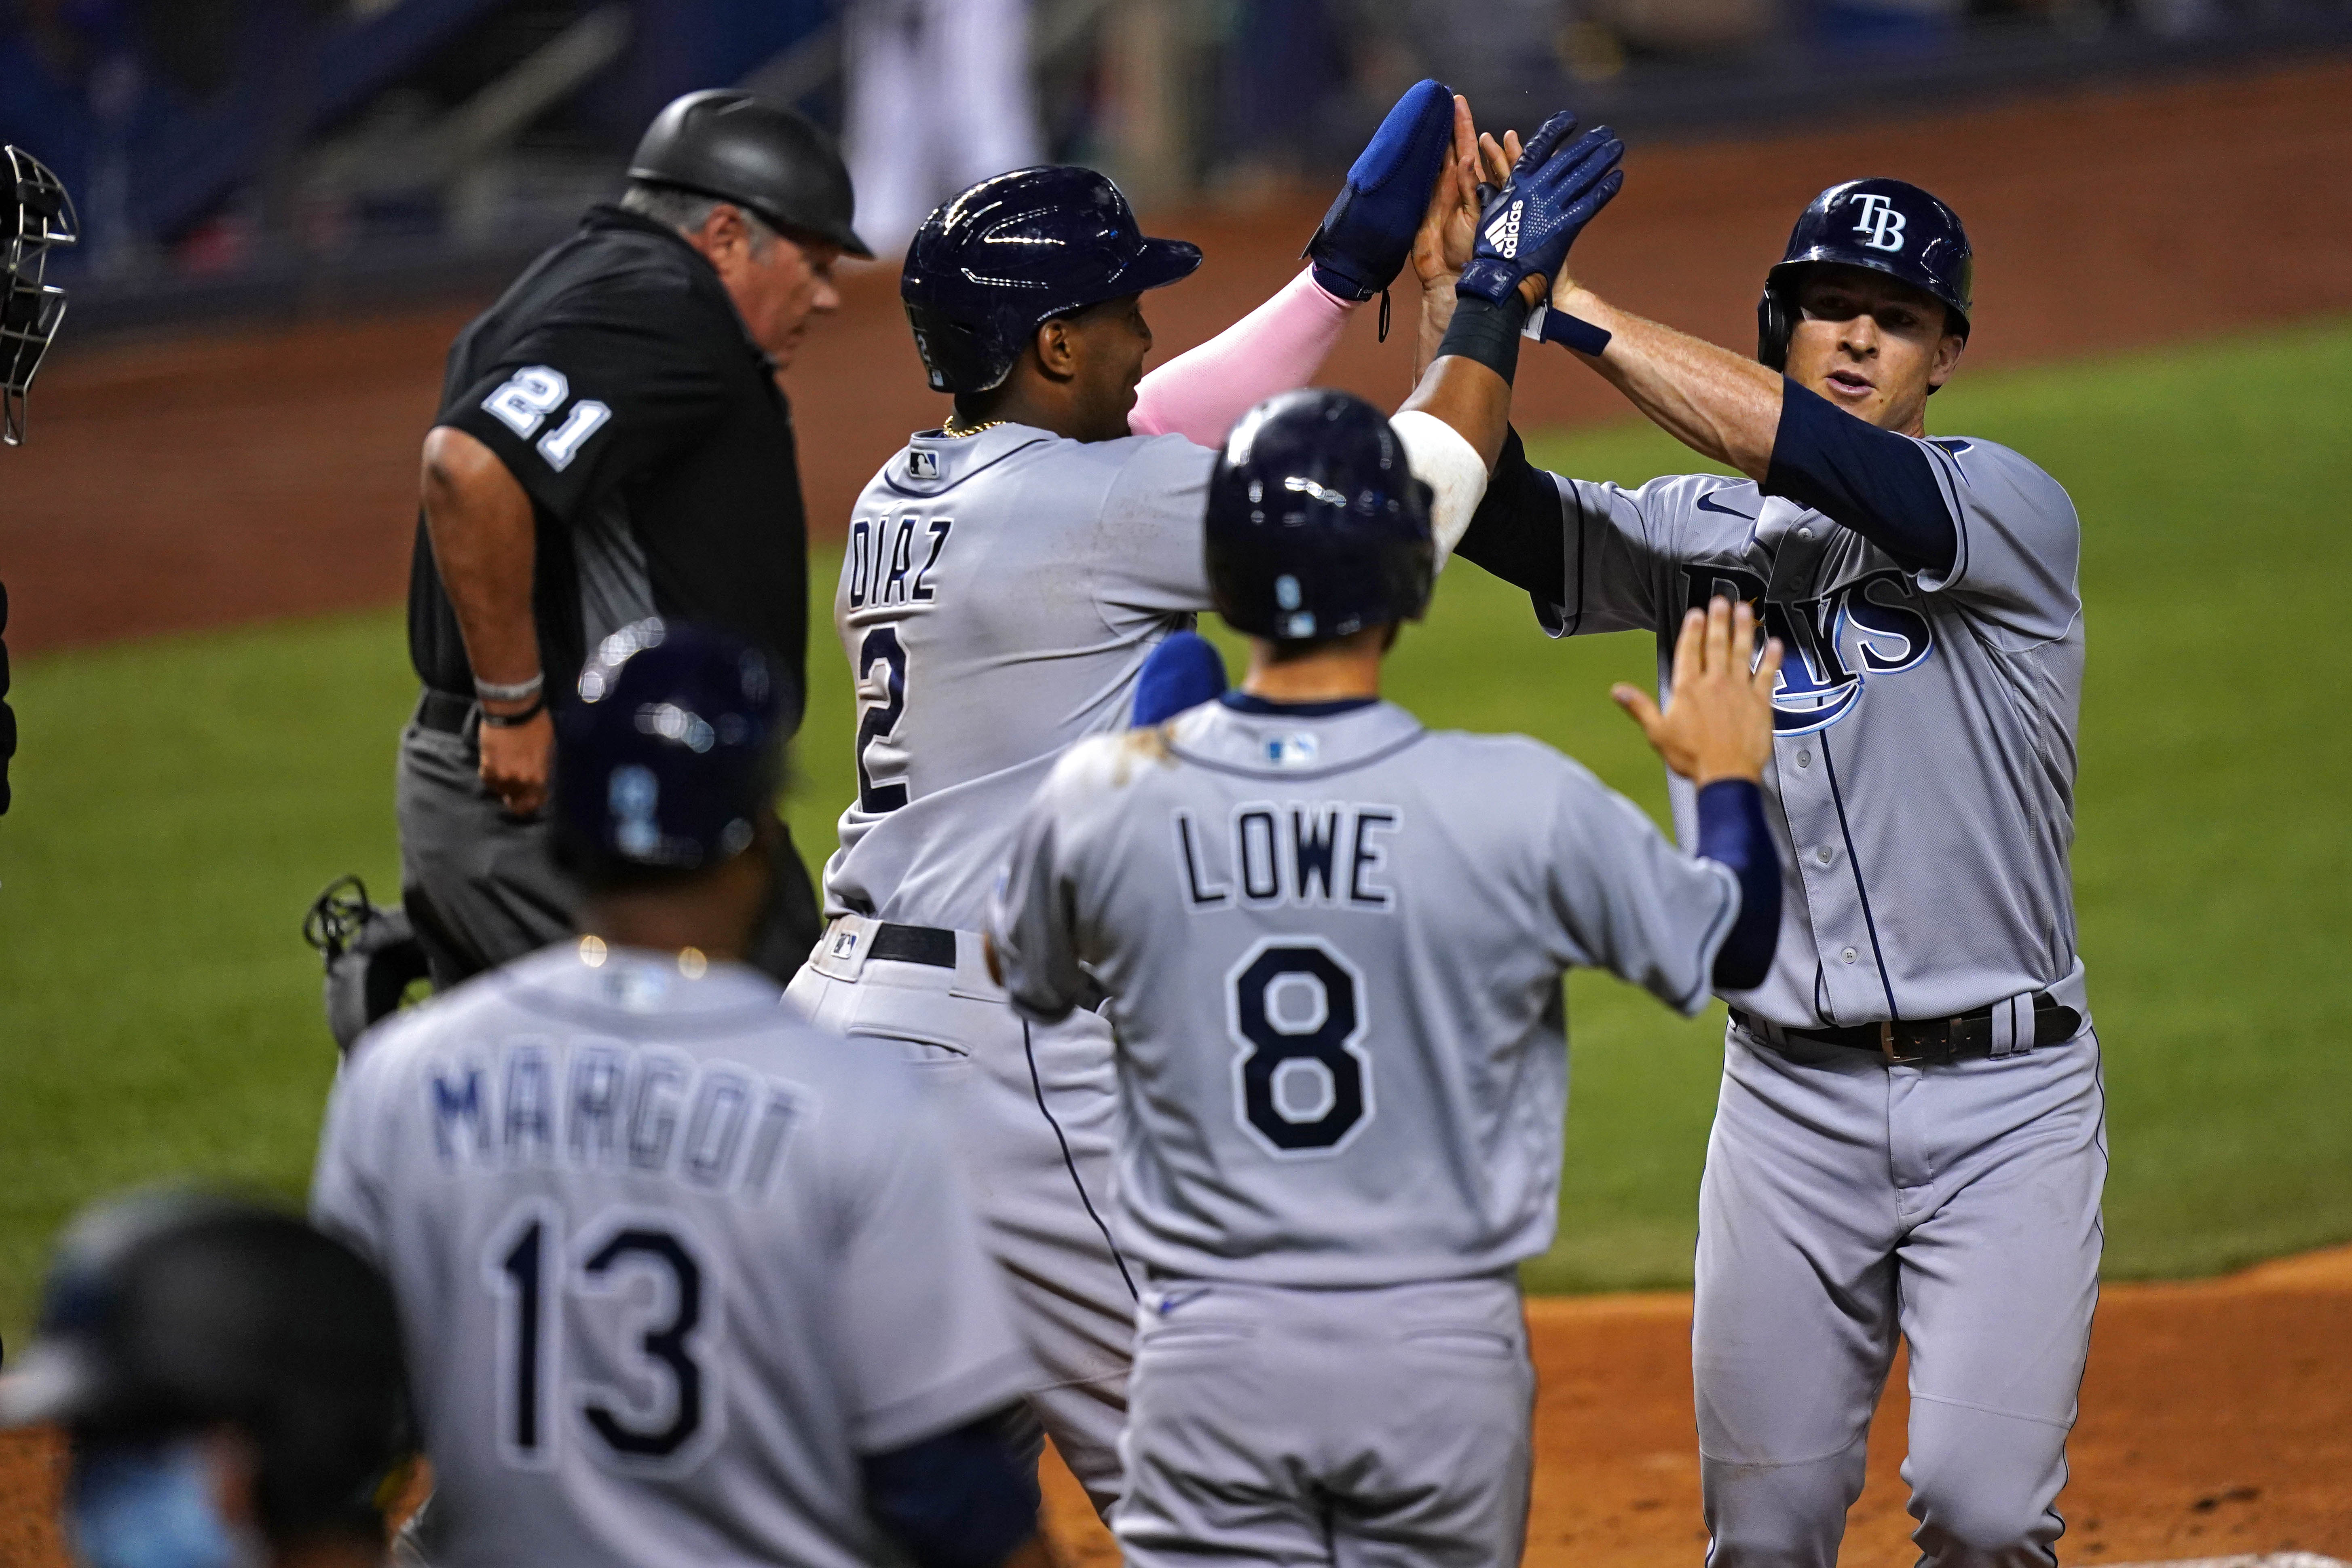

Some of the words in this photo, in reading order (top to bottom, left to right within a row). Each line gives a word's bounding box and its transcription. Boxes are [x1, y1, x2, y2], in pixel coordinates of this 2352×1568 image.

[1503, 200, 1524, 258] adidas
[1849, 194, 1906, 252] TB
[480, 365, 613, 465] 21
[849, 515, 955, 611] DIAZ
[856, 621, 911, 814] 2
[1172, 801, 1404, 914] LOWE
[1224, 935, 1375, 1160] 8
[424, 1036, 820, 1196] MARGOT
[485, 1200, 724, 1474] 13
